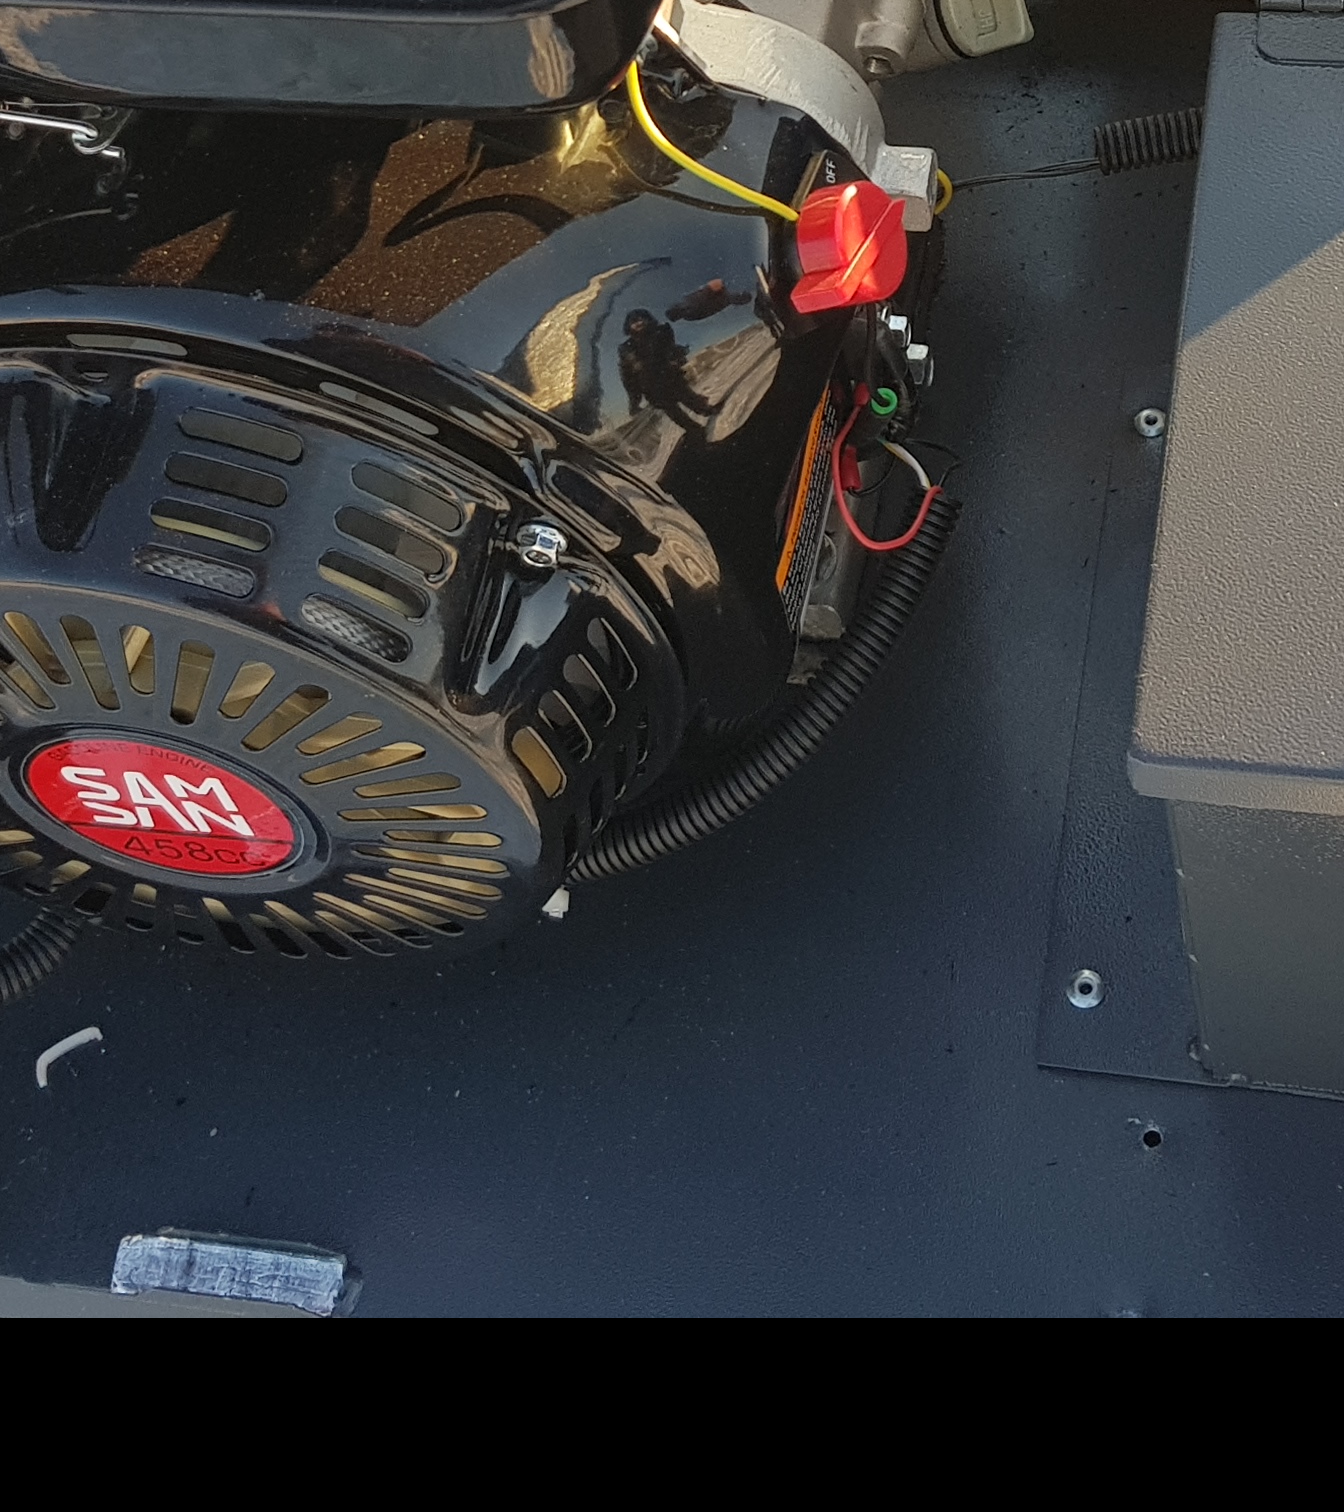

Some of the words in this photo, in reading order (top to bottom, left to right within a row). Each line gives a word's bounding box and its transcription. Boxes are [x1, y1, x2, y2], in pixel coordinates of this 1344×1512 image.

[825, 158, 837, 184] OFF
[137, 745, 215, 773] ENGINE
[60, 766, 239, 814] SAM
